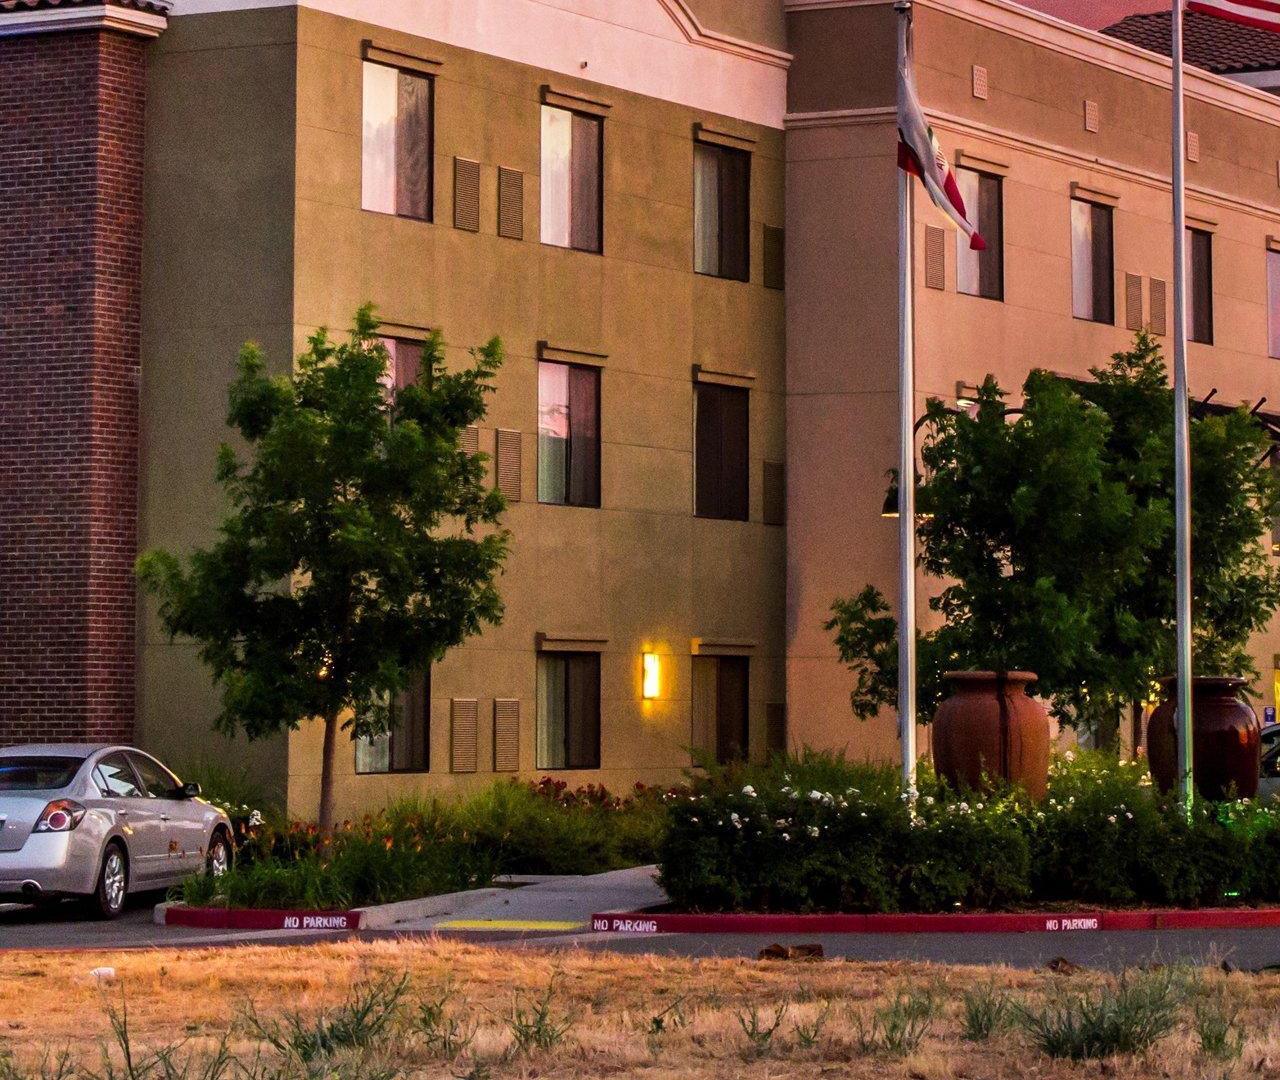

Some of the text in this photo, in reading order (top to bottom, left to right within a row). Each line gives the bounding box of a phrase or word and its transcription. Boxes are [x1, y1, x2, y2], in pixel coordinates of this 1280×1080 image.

[284, 916, 347, 928] NO PARKING
[594, 919, 658, 932] NO PARKING
[1046, 918, 1098, 931] NO PARKING
